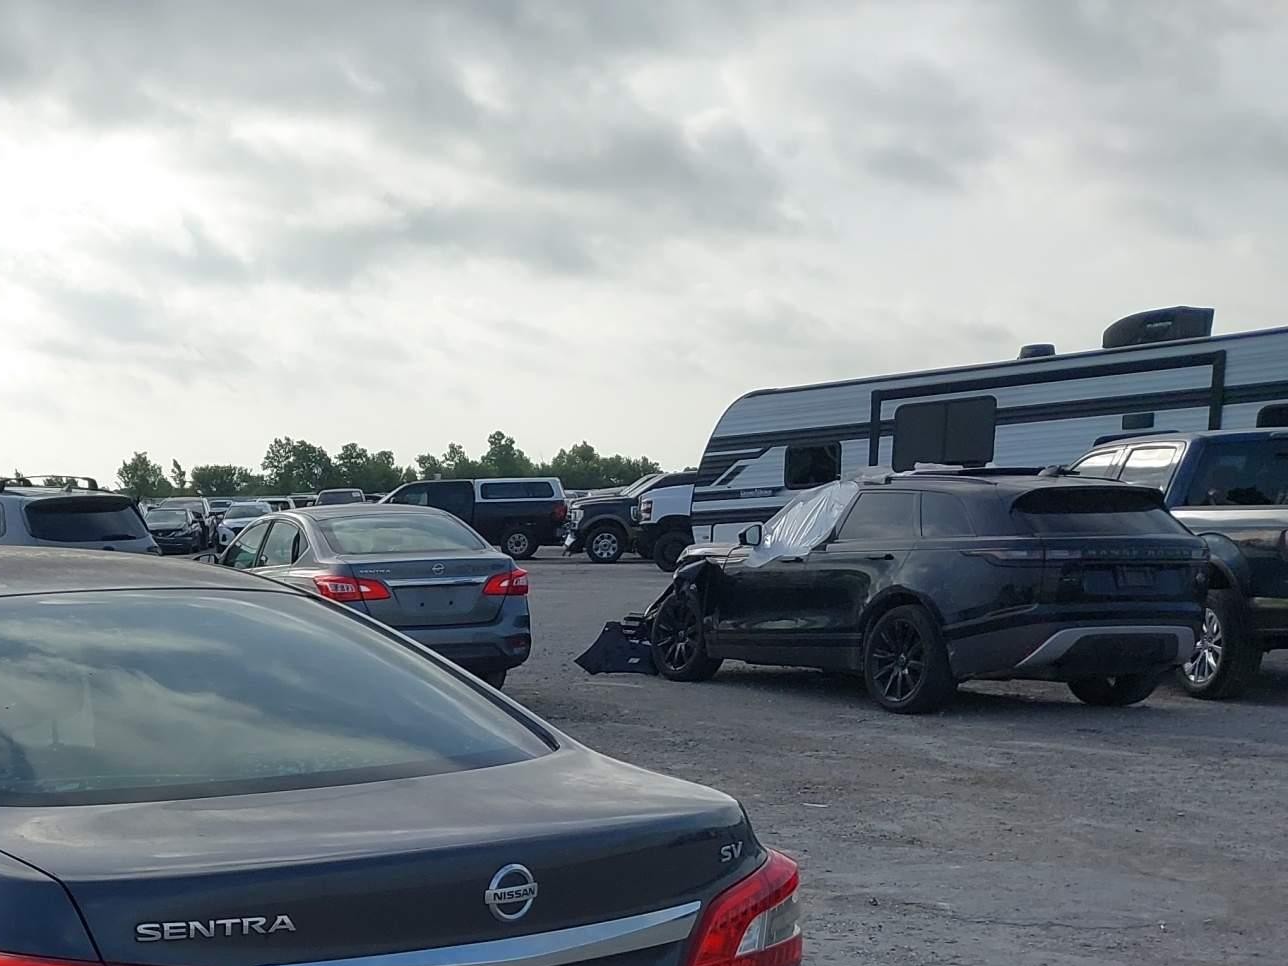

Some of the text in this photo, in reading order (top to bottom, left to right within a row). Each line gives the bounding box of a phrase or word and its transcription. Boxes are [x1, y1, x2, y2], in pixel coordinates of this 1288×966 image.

[720, 841, 743, 863] SV
[493, 887, 535, 901] NISSAN
[136, 914, 297, 942] SENTRA
